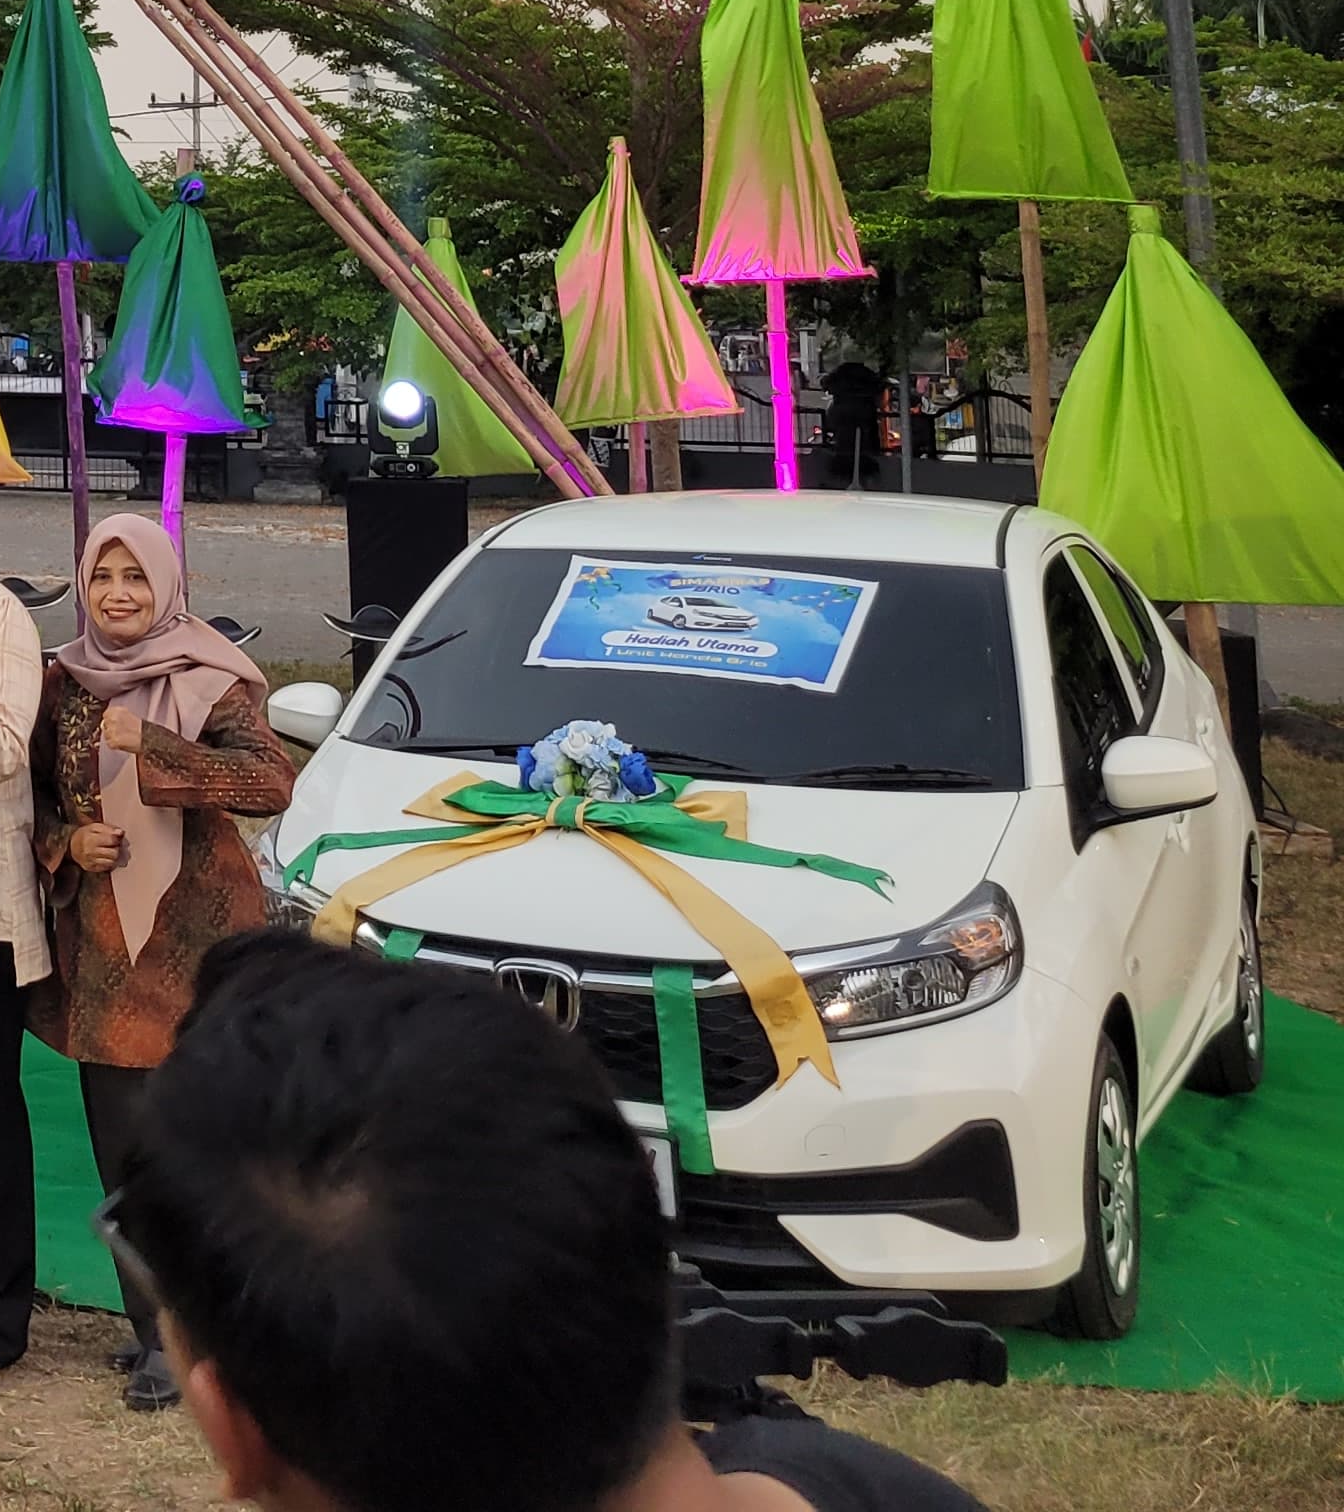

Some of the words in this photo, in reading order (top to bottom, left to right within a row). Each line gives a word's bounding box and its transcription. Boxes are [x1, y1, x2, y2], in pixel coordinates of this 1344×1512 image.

[693, 585, 741, 595] BRIO
[625, 633, 690, 648] Hadiah
[697, 638, 759, 654] Utama
[604, 646, 612, 656] 1
